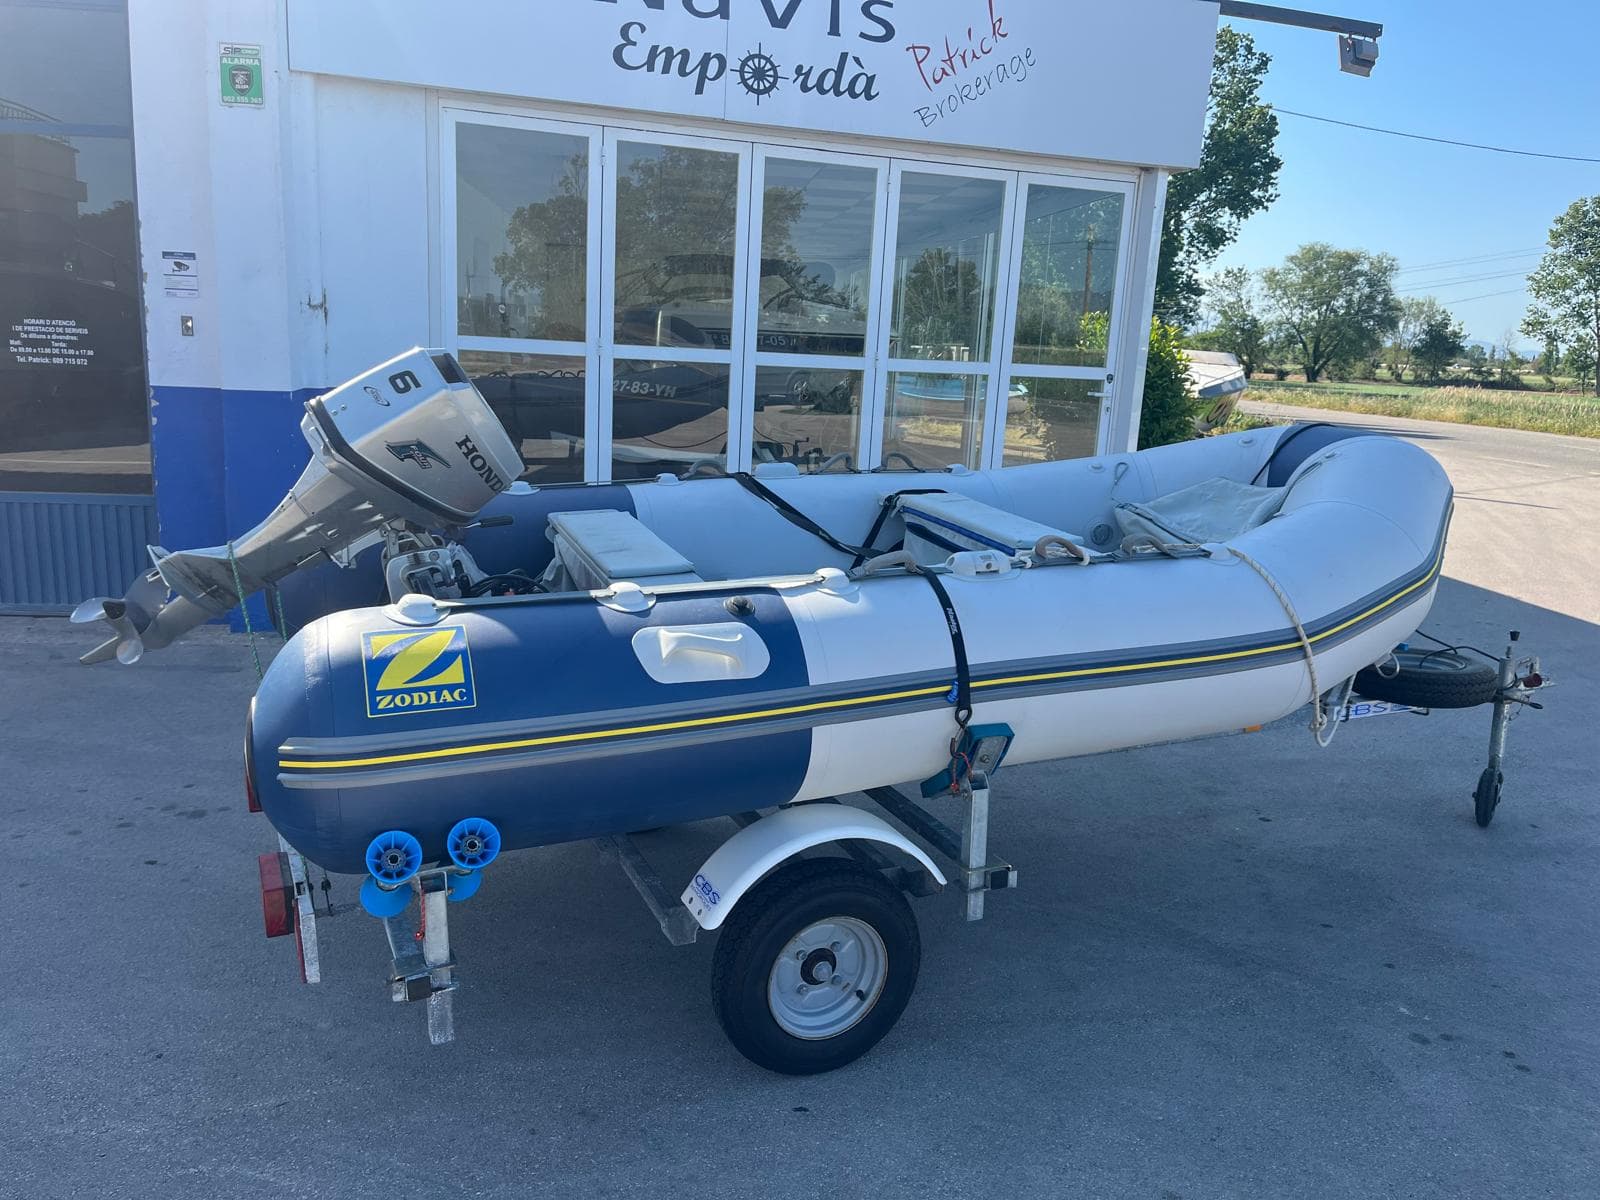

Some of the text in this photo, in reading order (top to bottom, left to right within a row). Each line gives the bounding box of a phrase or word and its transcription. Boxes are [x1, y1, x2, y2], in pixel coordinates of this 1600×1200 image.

[905, 0, 1009, 92] Patrick
[222, 57, 260, 66] ALARMA
[913, 47, 1037, 128] Brokerage
[28, 355, 52, 364] Patrick:
[388, 369, 422, 394] 6
[455, 434, 506, 492] HOND
[375, 688, 467, 710] ZODIAC
[695, 874, 721, 905] CBS
